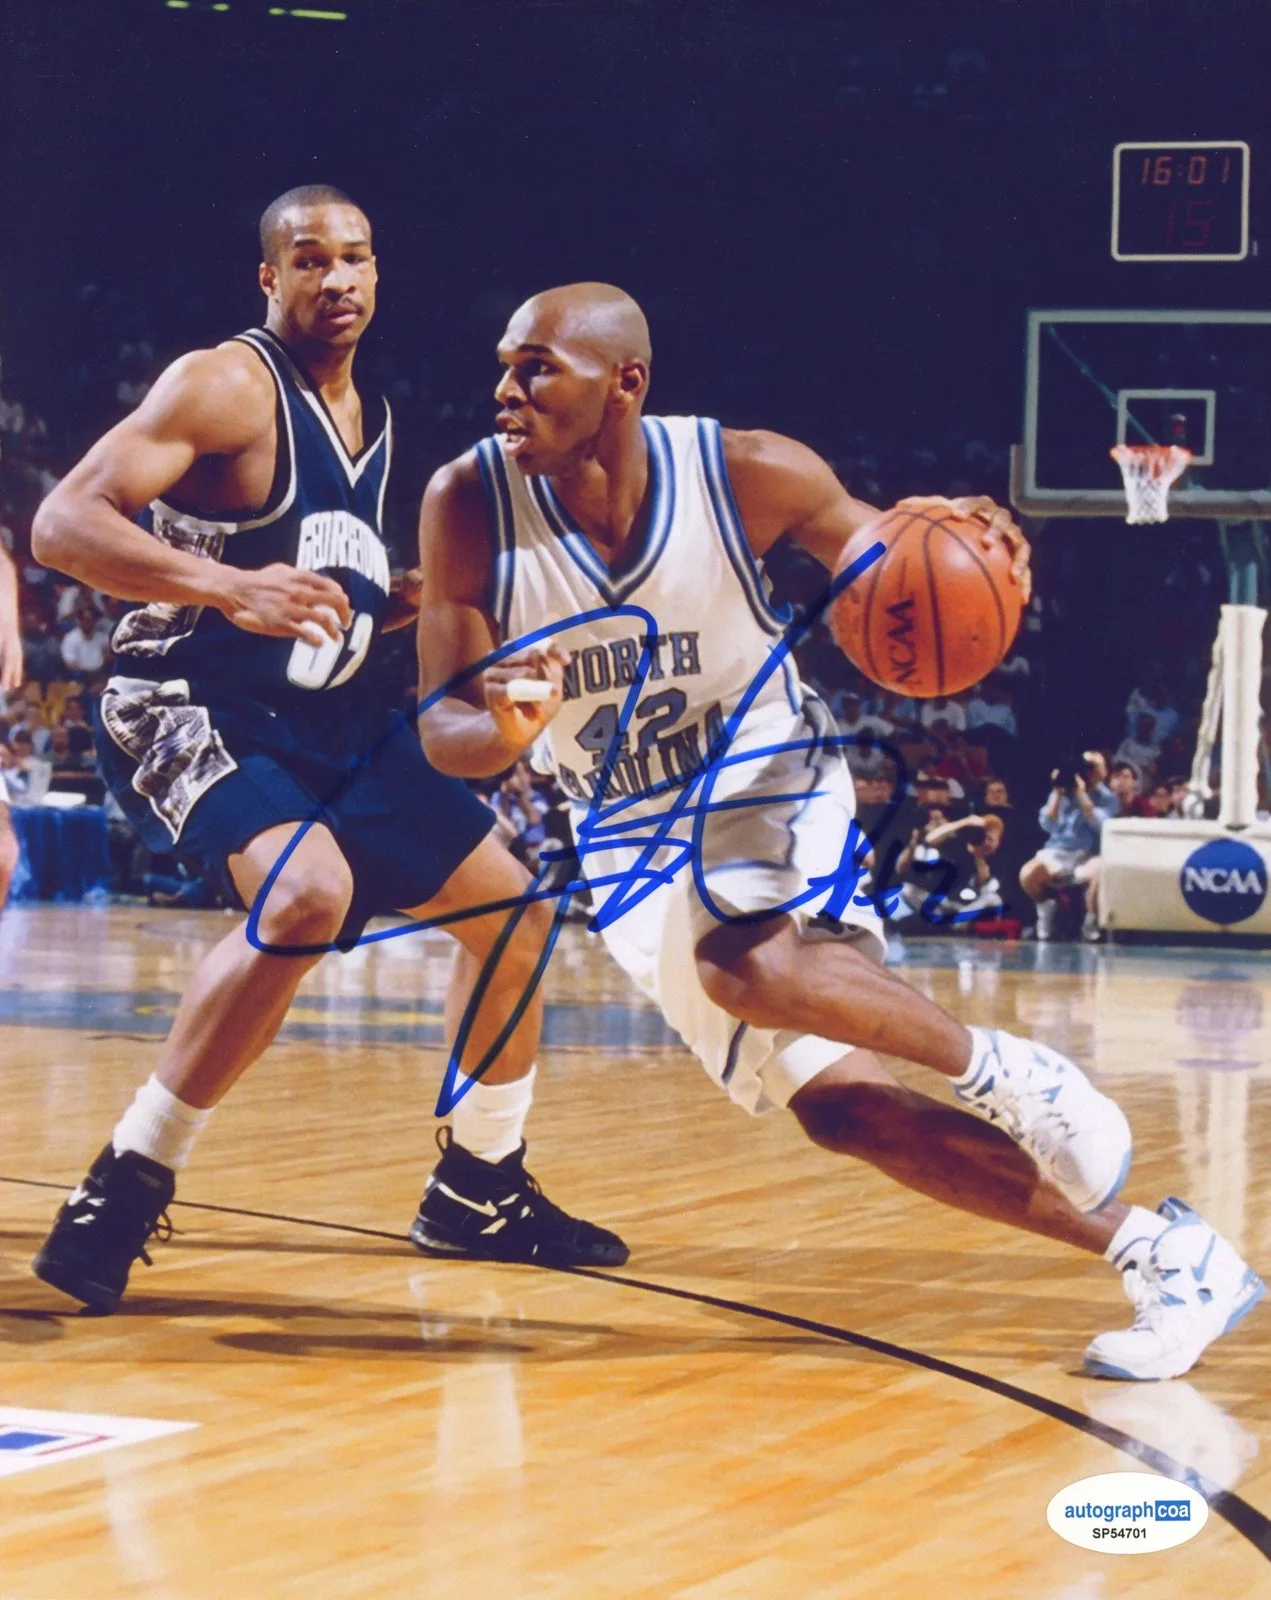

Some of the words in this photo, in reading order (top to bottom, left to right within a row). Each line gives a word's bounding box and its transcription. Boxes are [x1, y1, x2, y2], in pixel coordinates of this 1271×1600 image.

[1141, 156, 1231, 185] 16:01
[1164, 200, 1214, 247] 15
[562, 631, 702, 702] NORTH
[883, 592, 922, 690] NCAA
[558, 701, 732, 801] AROLINA
[574, 687, 688, 766] 42
[1183, 866, 1264, 895] NCAA
